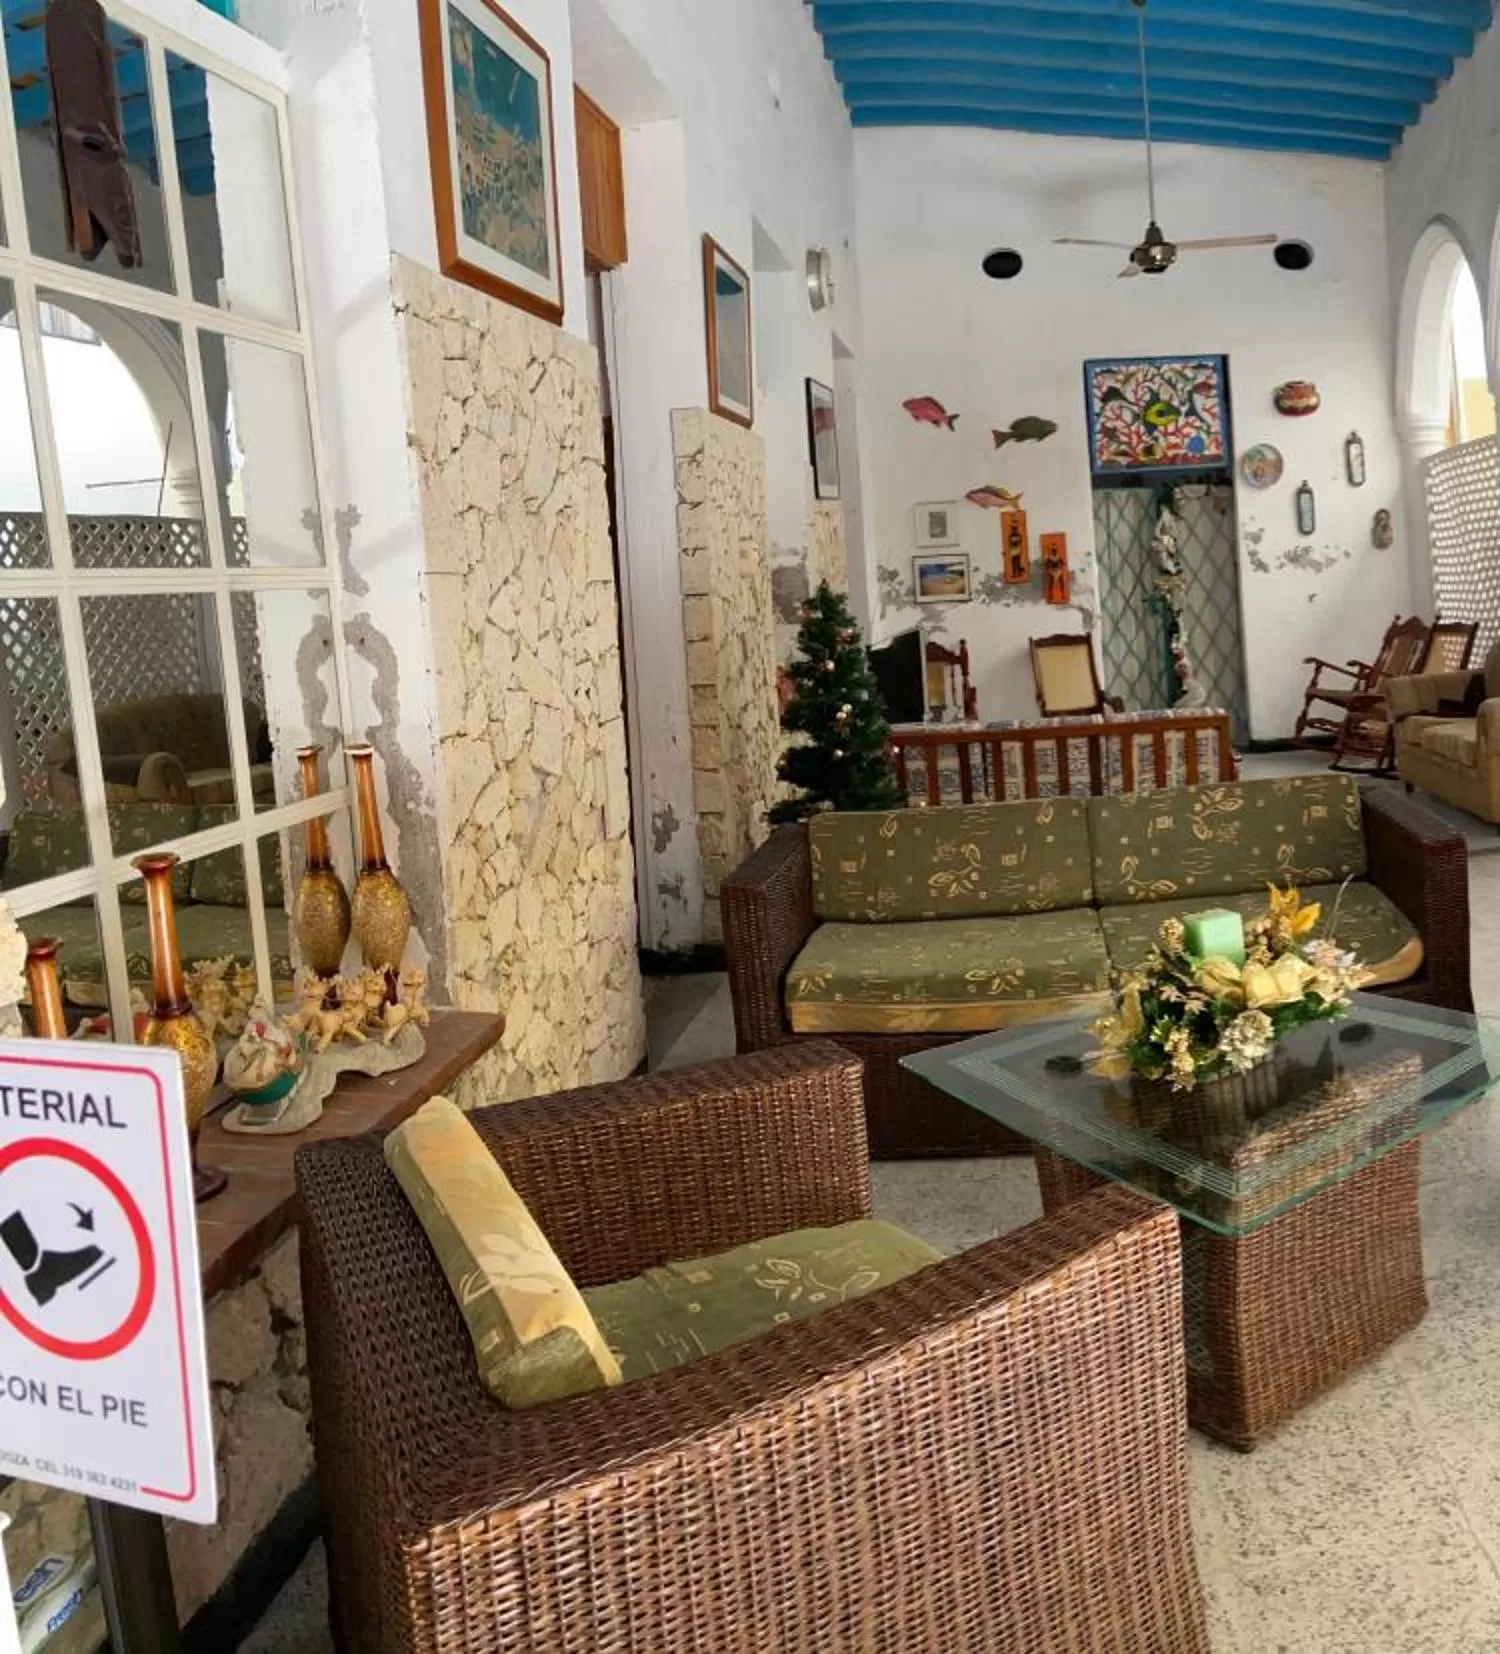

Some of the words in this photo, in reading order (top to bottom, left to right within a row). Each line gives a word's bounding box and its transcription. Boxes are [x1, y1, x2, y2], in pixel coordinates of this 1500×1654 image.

[0, 1085, 128, 1128] TERIAL
[57, 1385, 93, 1416] EL
[101, 1393, 148, 1428] PIE
